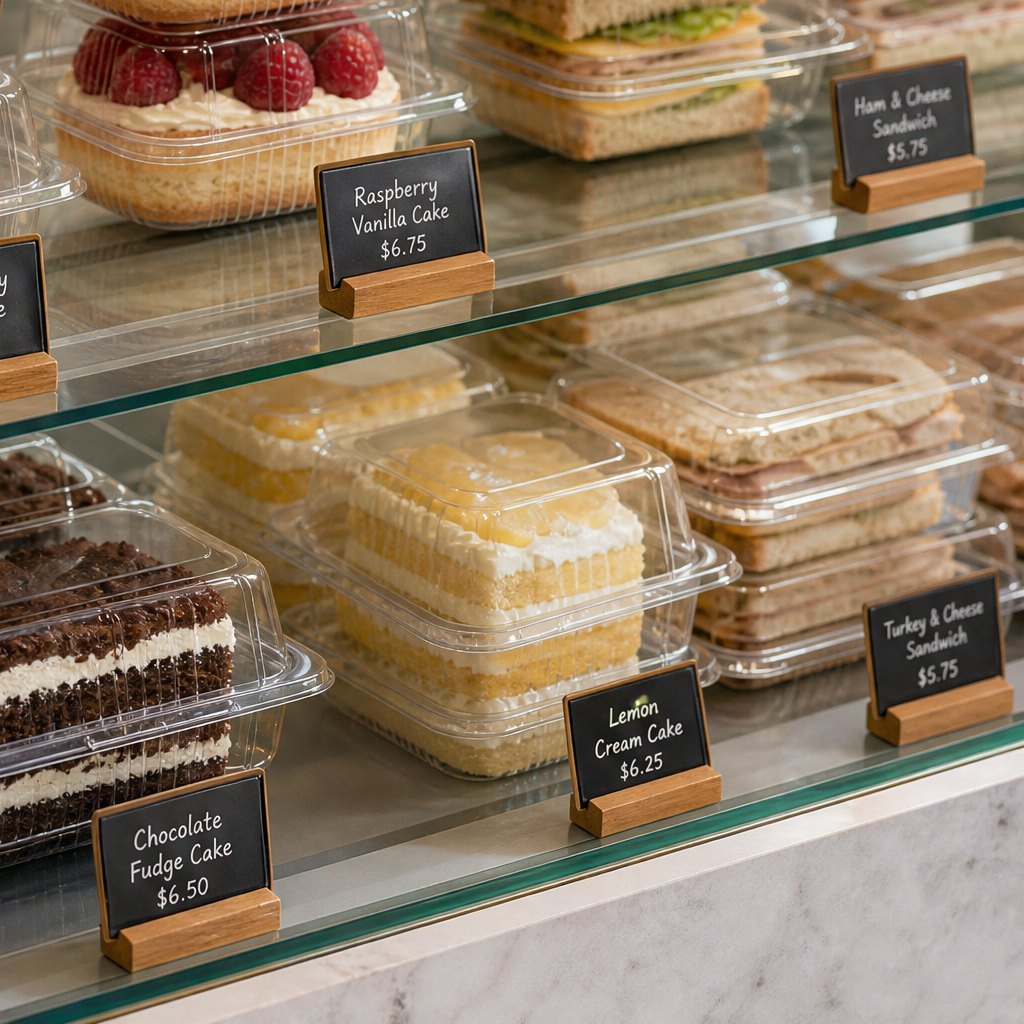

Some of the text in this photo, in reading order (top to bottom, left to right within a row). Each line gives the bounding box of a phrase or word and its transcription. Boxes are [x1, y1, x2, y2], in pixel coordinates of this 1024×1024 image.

[854, 84, 952, 117] Ham & Cheese
[872, 108, 938, 139] Sandwich
[887, 137, 928, 163] $5.75
[354, 179, 438, 209] Raspberry
[352, 202, 450, 235] Vanilla Cake
[380, 234, 427, 261] $6.75
[883, 601, 984, 639] Turkey & Cheese
[906, 625, 968, 660] Sandwich
[917, 658, 959, 688] $5.75
[609, 702, 659, 727] Lemon
[595, 718, 684, 759] Cream Cake
[620, 752, 663, 782] $6.25
[133, 812, 222, 851] Chocolate
[130, 837, 233, 883] Fudge Cake
[157, 877, 209, 910] $6.50
